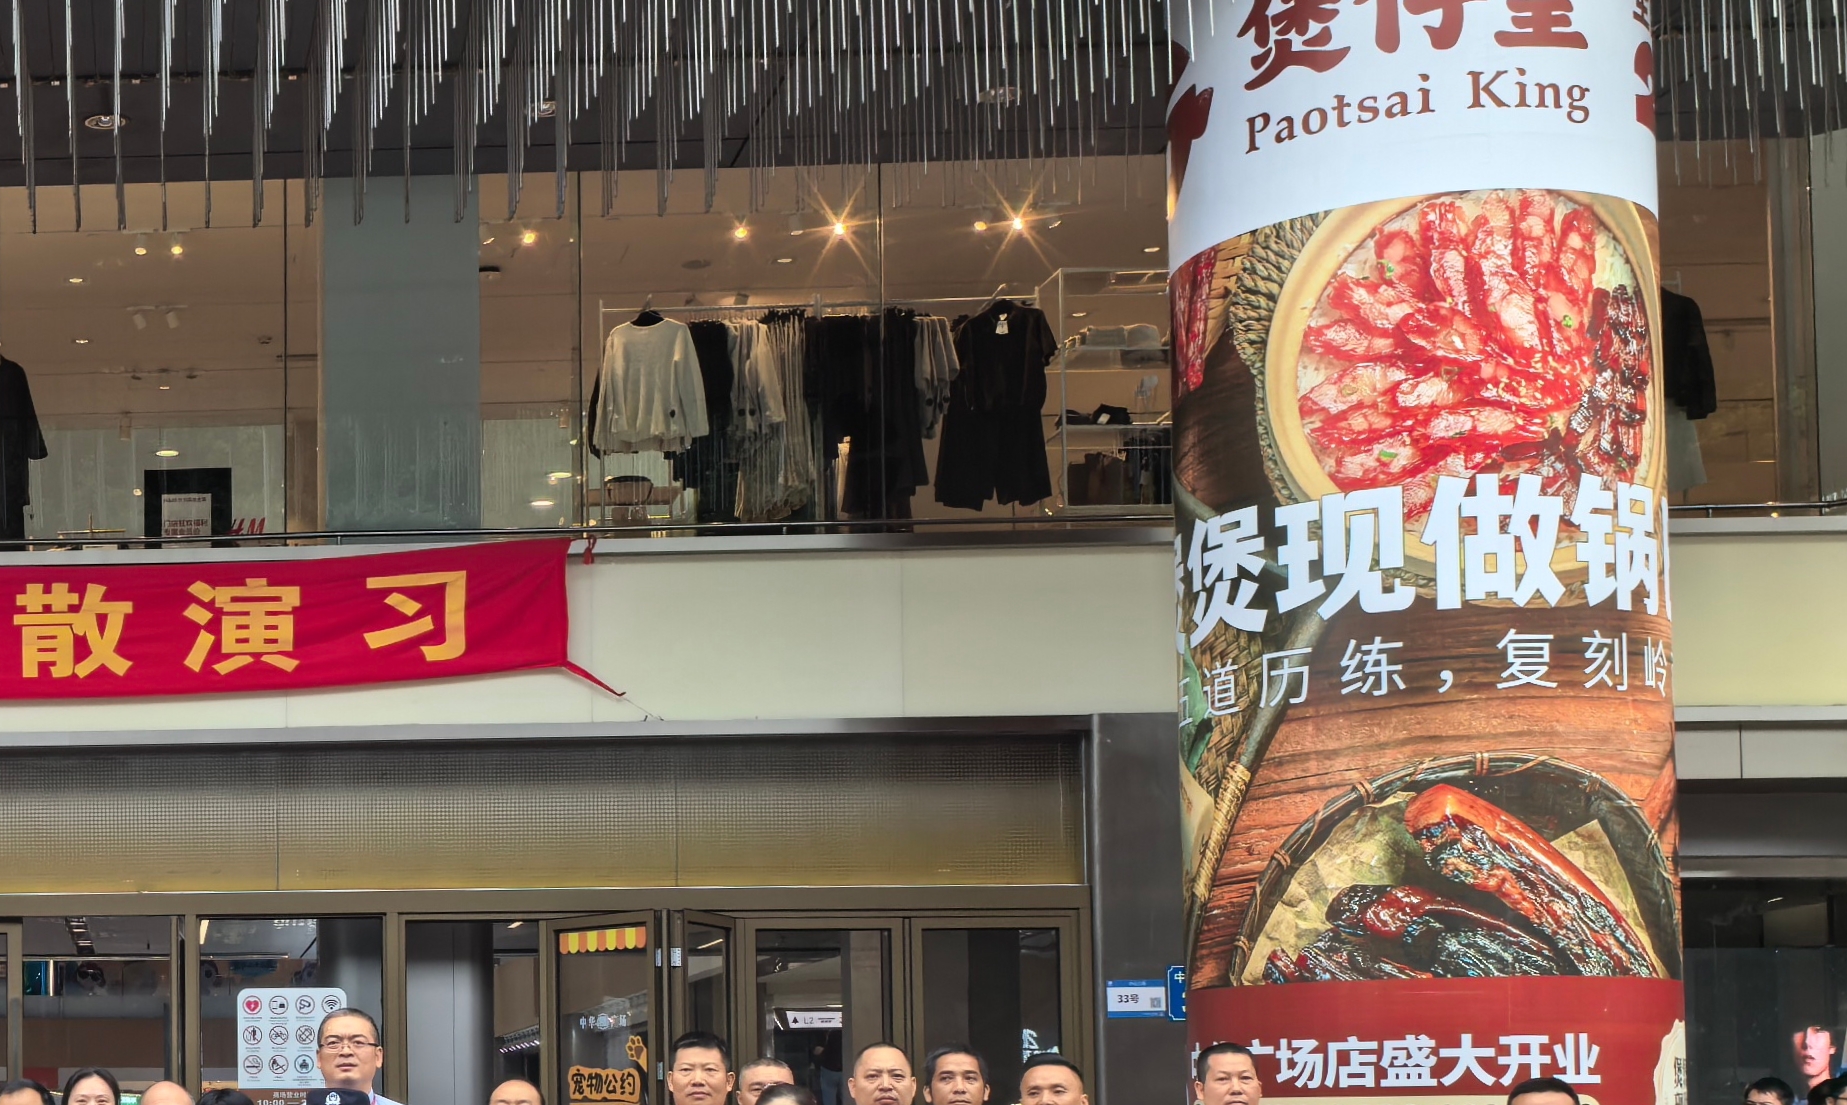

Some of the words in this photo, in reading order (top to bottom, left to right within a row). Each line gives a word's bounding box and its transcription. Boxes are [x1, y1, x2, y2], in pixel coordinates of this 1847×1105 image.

[1245, 73, 1436, 154] Paotsai
[1467, 67, 1591, 124] King
[1174, 473, 1673, 658] 煲现做锅
[1117, 993, 1140, 1004] 33号
[570, 1068, 637, 1096] 宠物公约
[1191, 1032, 1602, 1090] 广场店盛大开业
[272, 1091, 308, 1099] 商场营业时
